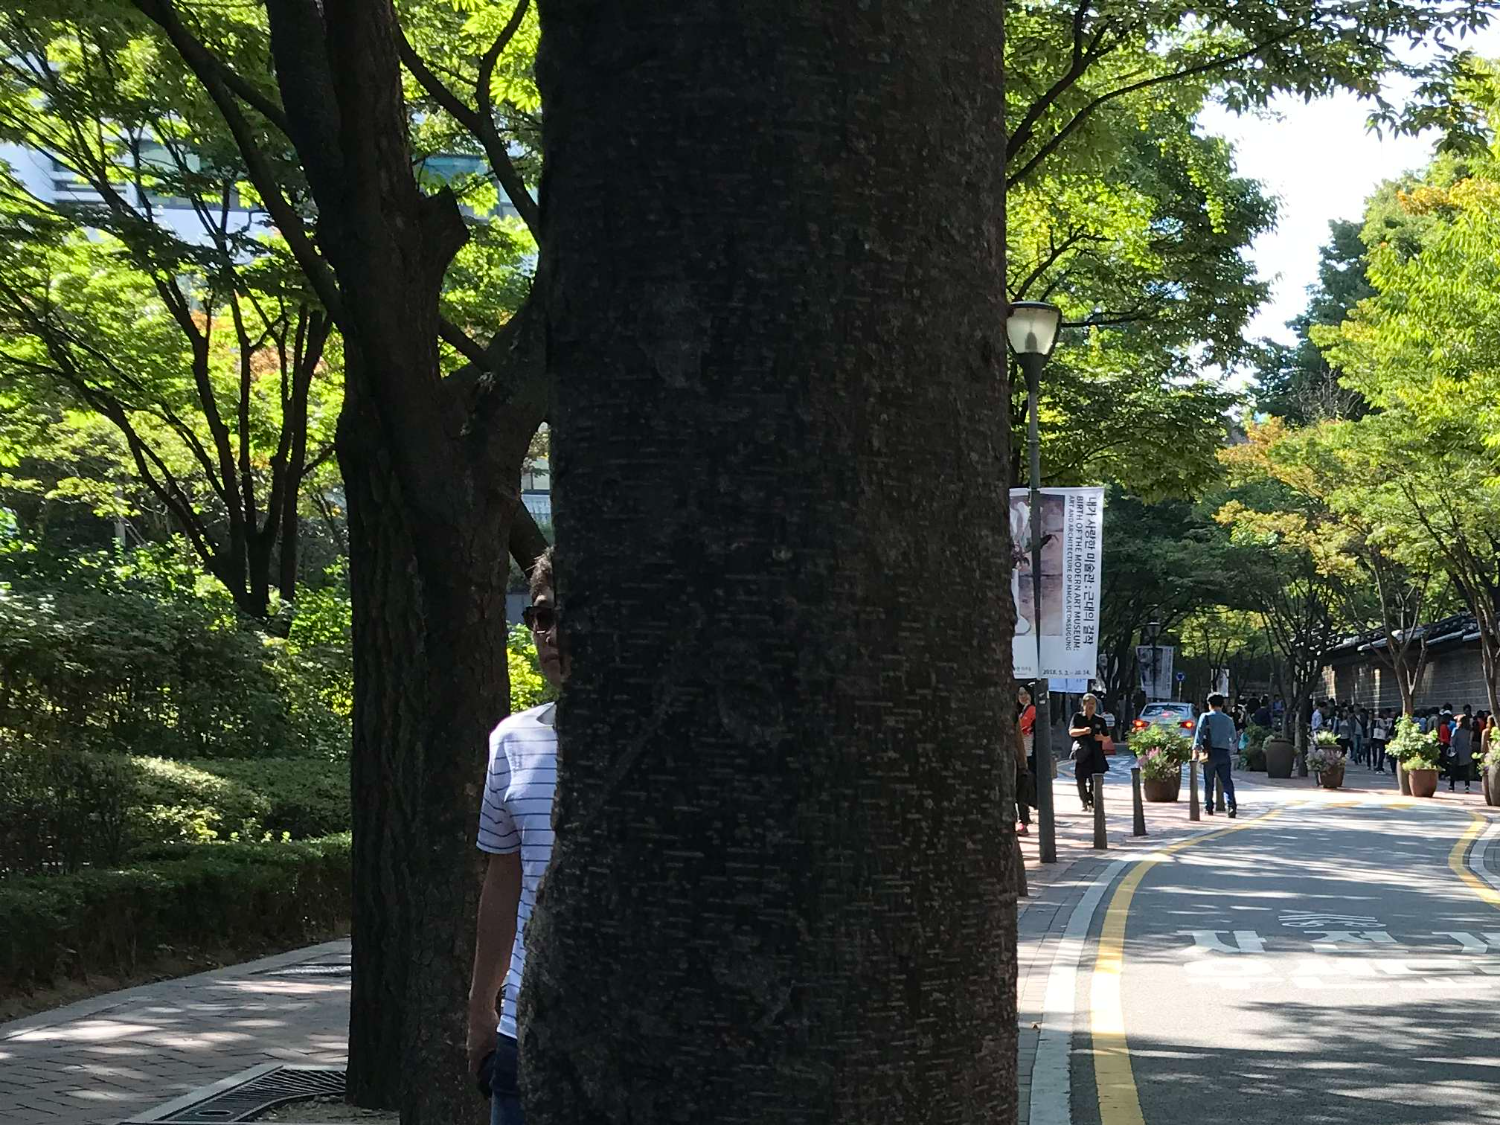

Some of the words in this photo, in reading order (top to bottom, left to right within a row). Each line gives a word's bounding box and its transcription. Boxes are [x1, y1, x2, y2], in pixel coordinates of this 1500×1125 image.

[1086, 497, 1097, 516] 내가
[1076, 523, 1082, 534] OF
[1085, 520, 1096, 549] 사랑한
[1074, 555, 1082, 591] MODERN
[1083, 591, 1094, 621] 근대의
[1083, 625, 1094, 645] 걸작
